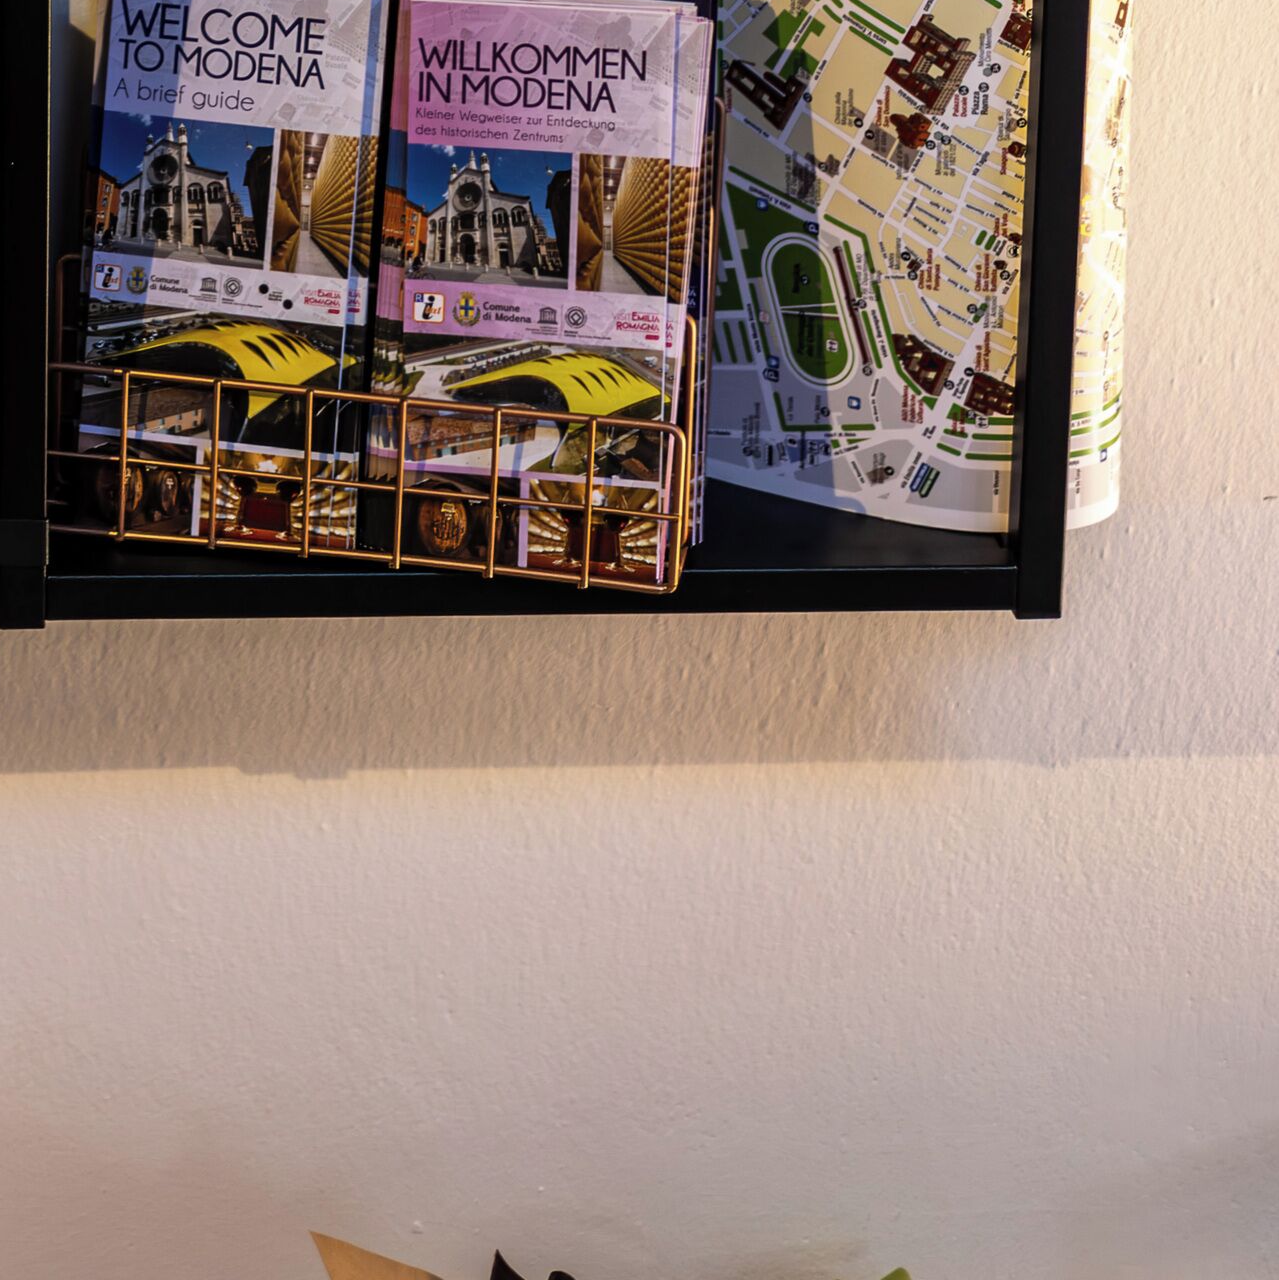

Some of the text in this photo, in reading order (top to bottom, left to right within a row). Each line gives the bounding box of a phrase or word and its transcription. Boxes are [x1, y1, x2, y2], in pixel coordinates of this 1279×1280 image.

[121, 0, 326, 56] WELCOME
[118, 39, 326, 91] TO MODENA
[418, 37, 648, 81] WILLKOMMEN
[113, 78, 255, 113] A brief guide
[418, 71, 618, 114] IN MODENA
[980, 94, 989, 116] Roma
[416, 106, 617, 132] Kleiner Wegweiser zur Entdeckung
[415, 124, 564, 144] des historischen Zentrums
[149, 282, 189, 295] di Modena
[150, 274, 181, 286] Comune
[303, 296, 342, 308] ROMAGNA
[317, 288, 342, 300] EMILIA
[483, 301, 521, 314] Comune
[482, 311, 532, 325] di Modena
[631, 311, 661, 324] EMILIA
[616, 320, 661, 333] ROMAGNA
